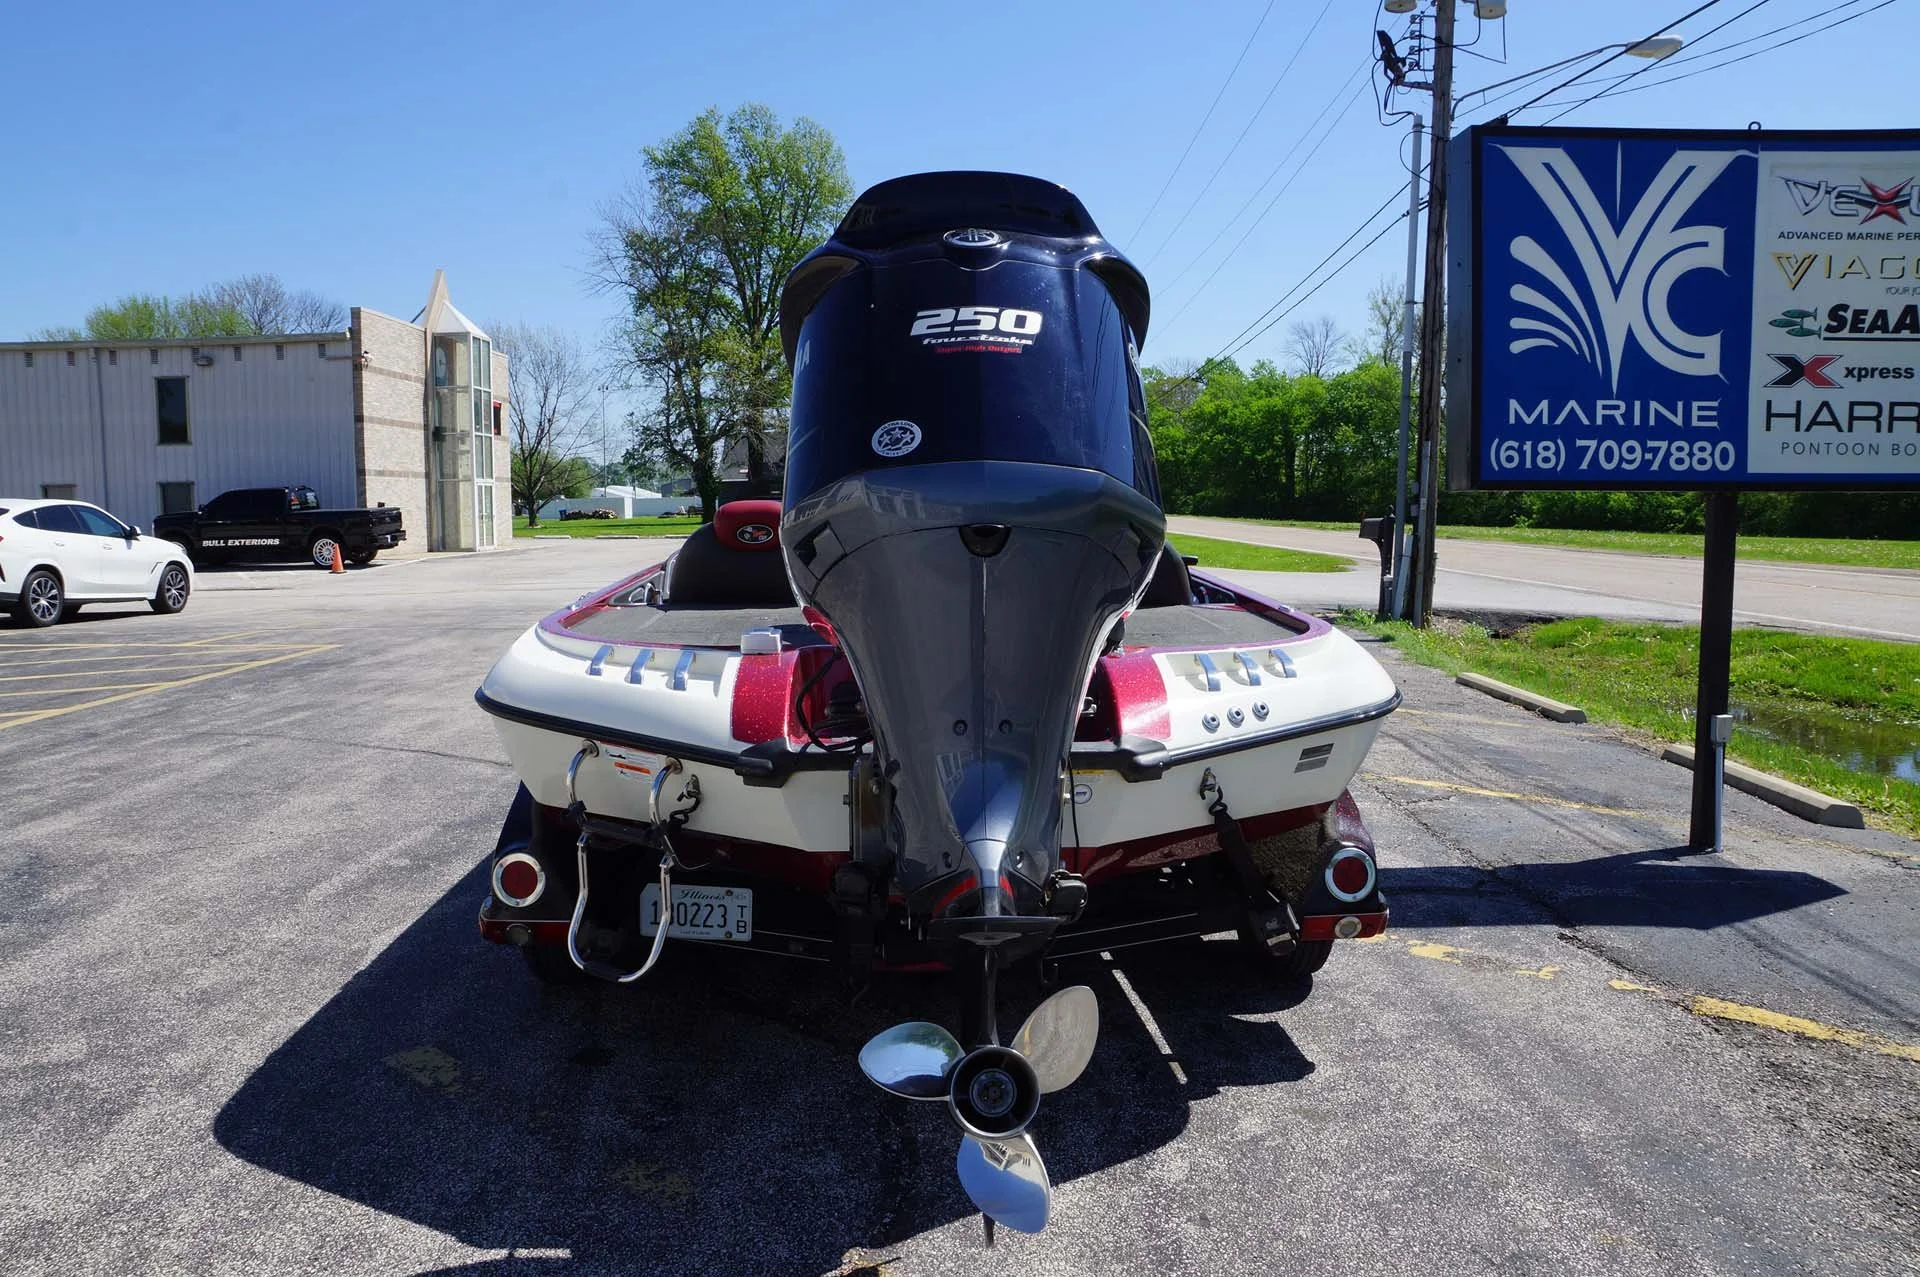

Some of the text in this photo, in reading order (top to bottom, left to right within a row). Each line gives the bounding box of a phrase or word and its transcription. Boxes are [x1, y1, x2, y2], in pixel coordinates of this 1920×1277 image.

[1777, 231, 1920, 241] ADVANCED MARINE PER
[1886, 286, 1910, 295] YOUR
[909, 306, 1043, 336] 250
[1844, 366, 1915, 382] xpress
[1508, 398, 1720, 429] MARINE
[1765, 400, 1920, 434] HARR
[1490, 438, 1736, 472] (618) 709-7880
[1781, 441, 1880, 456] PONTOON
[202, 538, 280, 547] BULL EXTERIORS
[680, 888, 726, 900] Illinois
